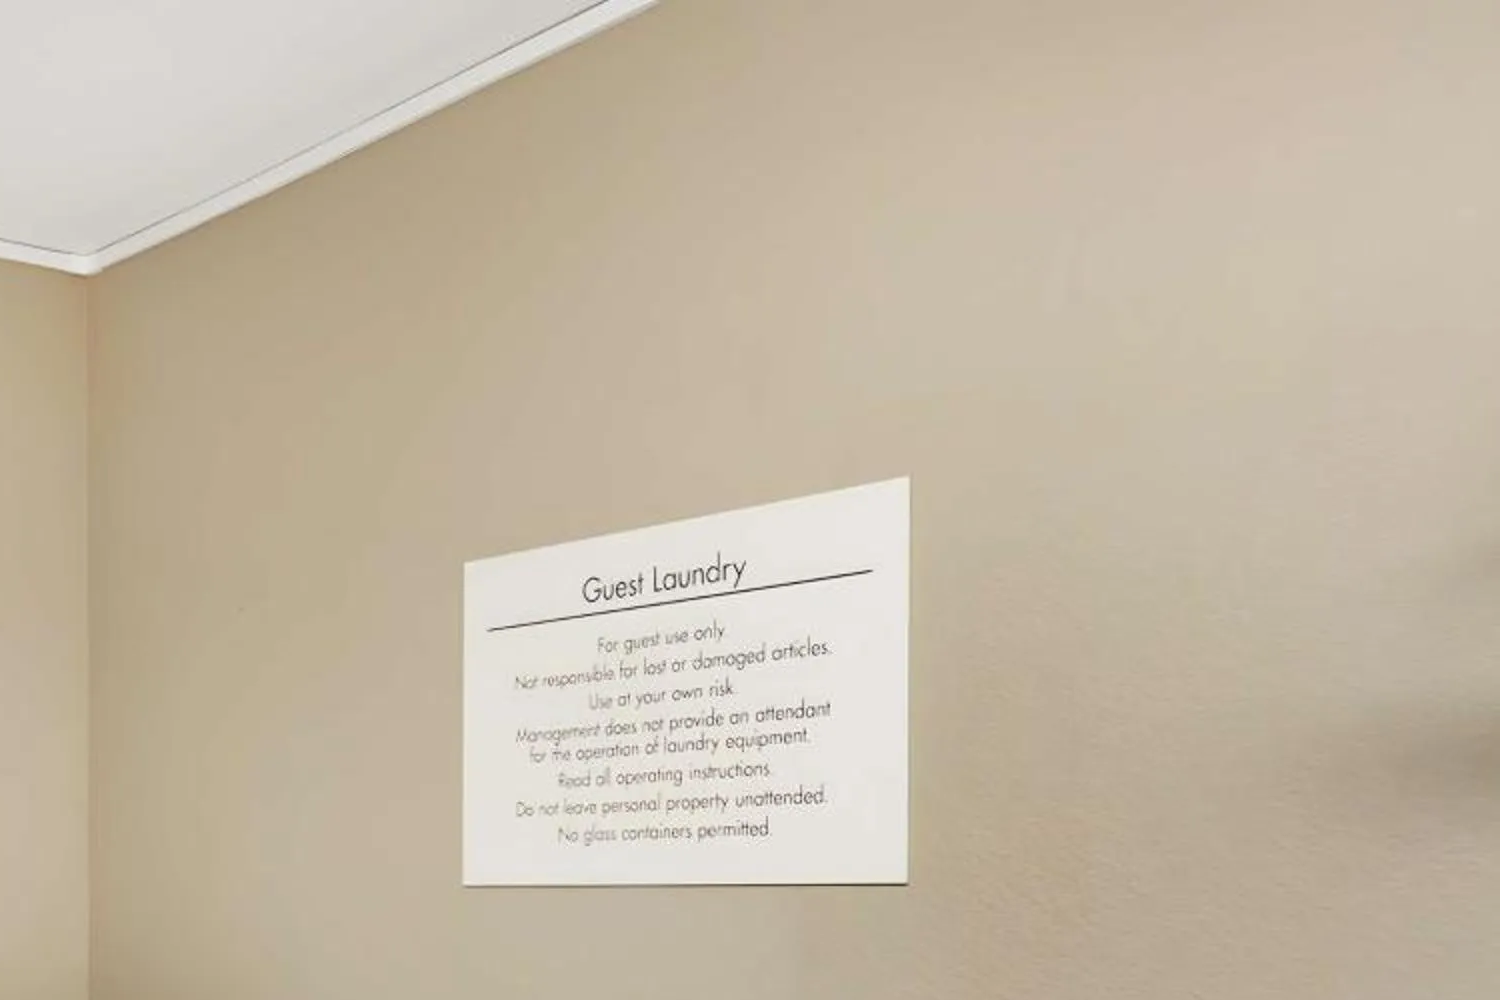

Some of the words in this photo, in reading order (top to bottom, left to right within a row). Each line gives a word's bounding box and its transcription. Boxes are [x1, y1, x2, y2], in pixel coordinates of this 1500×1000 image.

[581, 572, 644, 603] Guest
[653, 550, 747, 592] Laundry
[597, 636, 618, 653] For
[623, 631, 661, 655] guest
[665, 630, 689, 645] use
[515, 674, 538, 690] Not
[542, 664, 615, 688] responsible
[619, 661, 637, 680] for
[644, 656, 667, 676] lost
[671, 658, 687, 673] or
[692, 642, 766, 671] damaged
[771, 634, 833, 662] articles.
[588, 692, 613, 710] Use
[617, 693, 631, 707] at
[635, 691, 666, 710] your
[671, 686, 704, 702] own
[515, 723, 601, 747] Management
[605, 717, 637, 737] does
[642, 718, 664, 734] not
[669, 705, 724, 734] provide
[729, 711, 750, 726] an
[755, 696, 831, 724] attendant
[530, 745, 547, 763] for
[552, 744, 571, 761] the
[575, 743, 639, 763] operation
[645, 735, 659, 755] of
[663, 732, 720, 755] laundry
[558, 768, 591, 788] Read
[595, 766, 611, 787] all
[615, 766, 683, 790] operating
[516, 801, 534, 818] Do
[540, 803, 559, 817] not
[564, 798, 598, 816] leave
[601, 792, 661, 817] personal
[666, 792, 728, 815] property
[558, 827, 579, 845] No
[583, 824, 617, 847] glass
[621, 823, 693, 842] containers
[697, 816, 773, 843] permitted.
